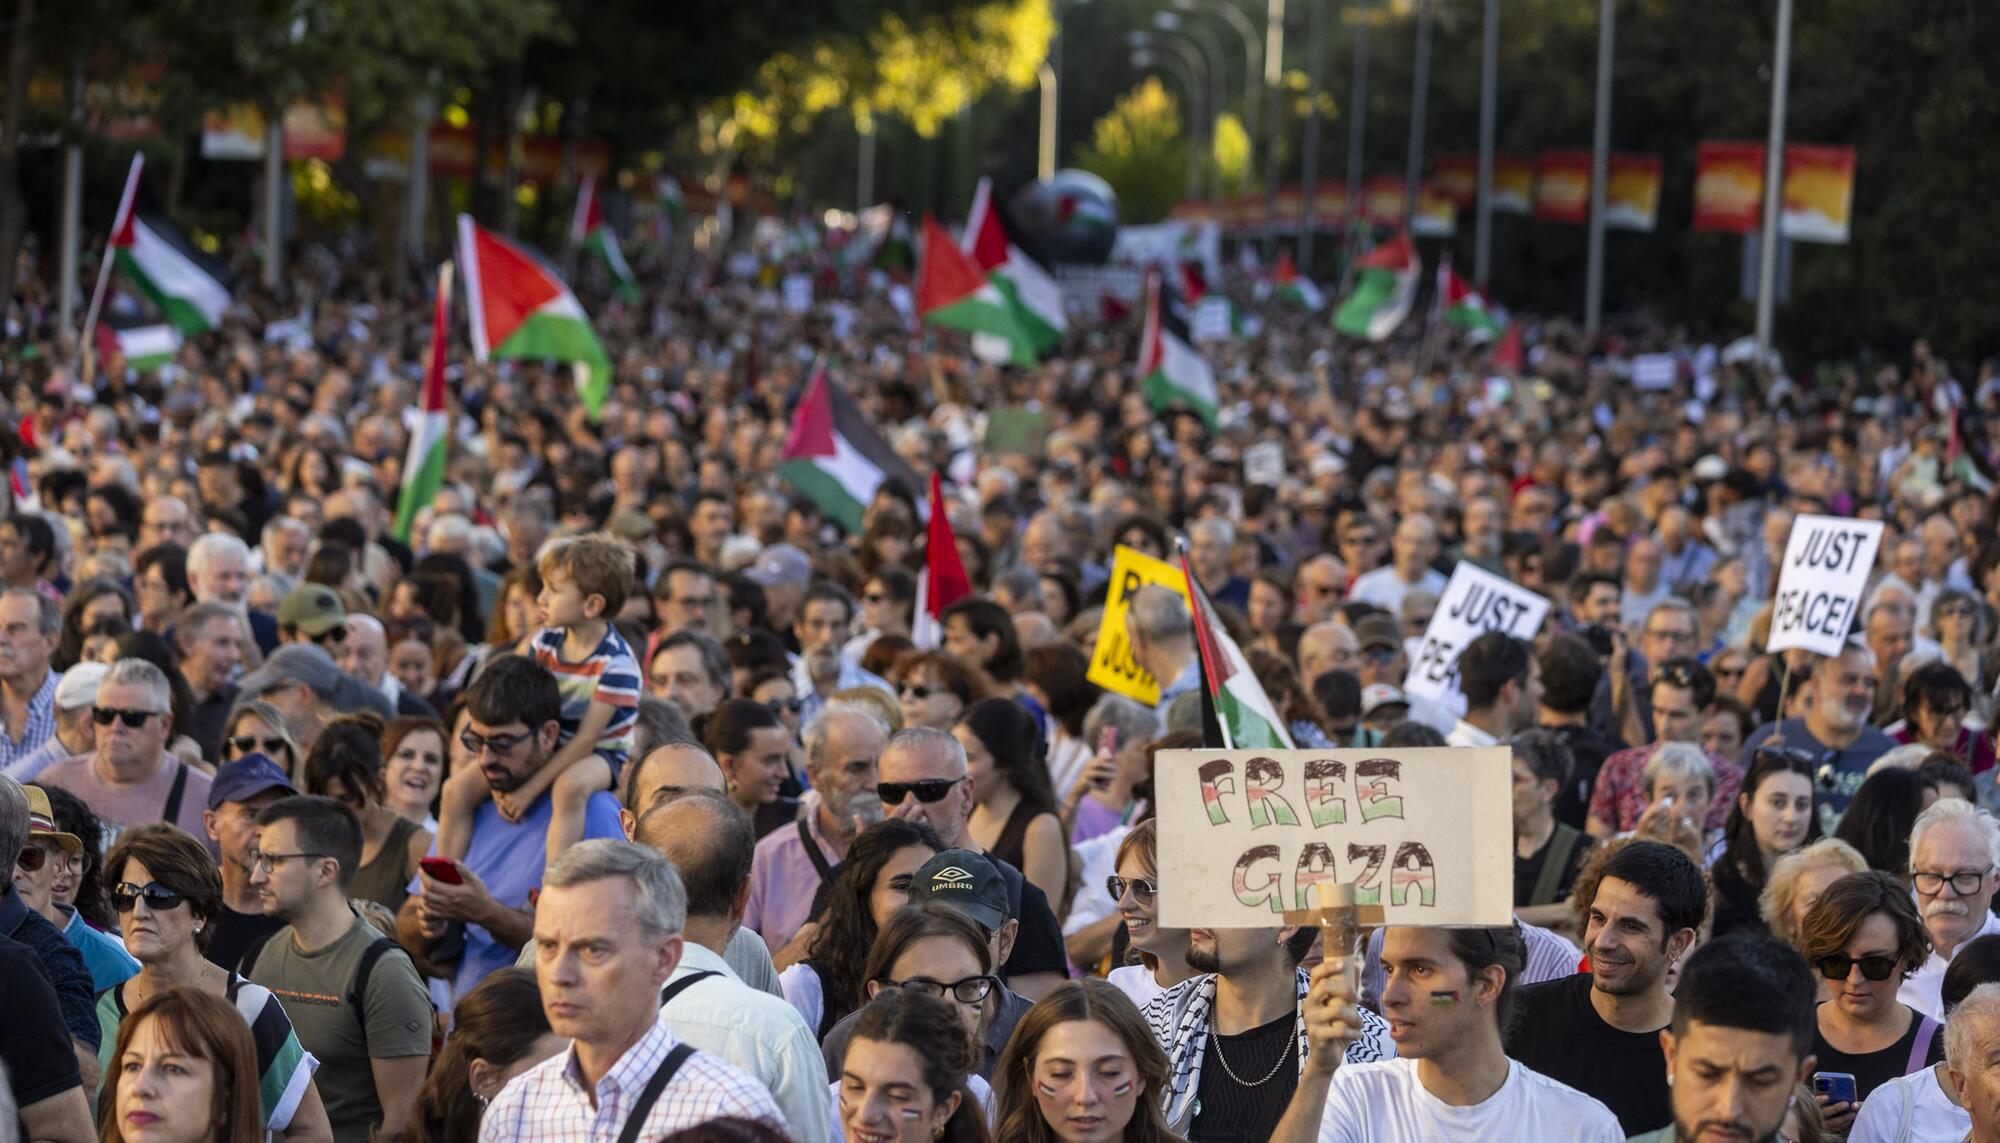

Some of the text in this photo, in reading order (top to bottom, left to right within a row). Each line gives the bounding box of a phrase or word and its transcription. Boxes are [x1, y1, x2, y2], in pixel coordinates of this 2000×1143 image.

[1795, 528, 1868, 573] JUST
[1450, 581, 1530, 634] JUST
[1776, 590, 1854, 638] PEACE!
[1198, 756, 1405, 831] FREE
[931, 882, 973, 892] UMBRO
[1231, 841, 1436, 913] GAZA
